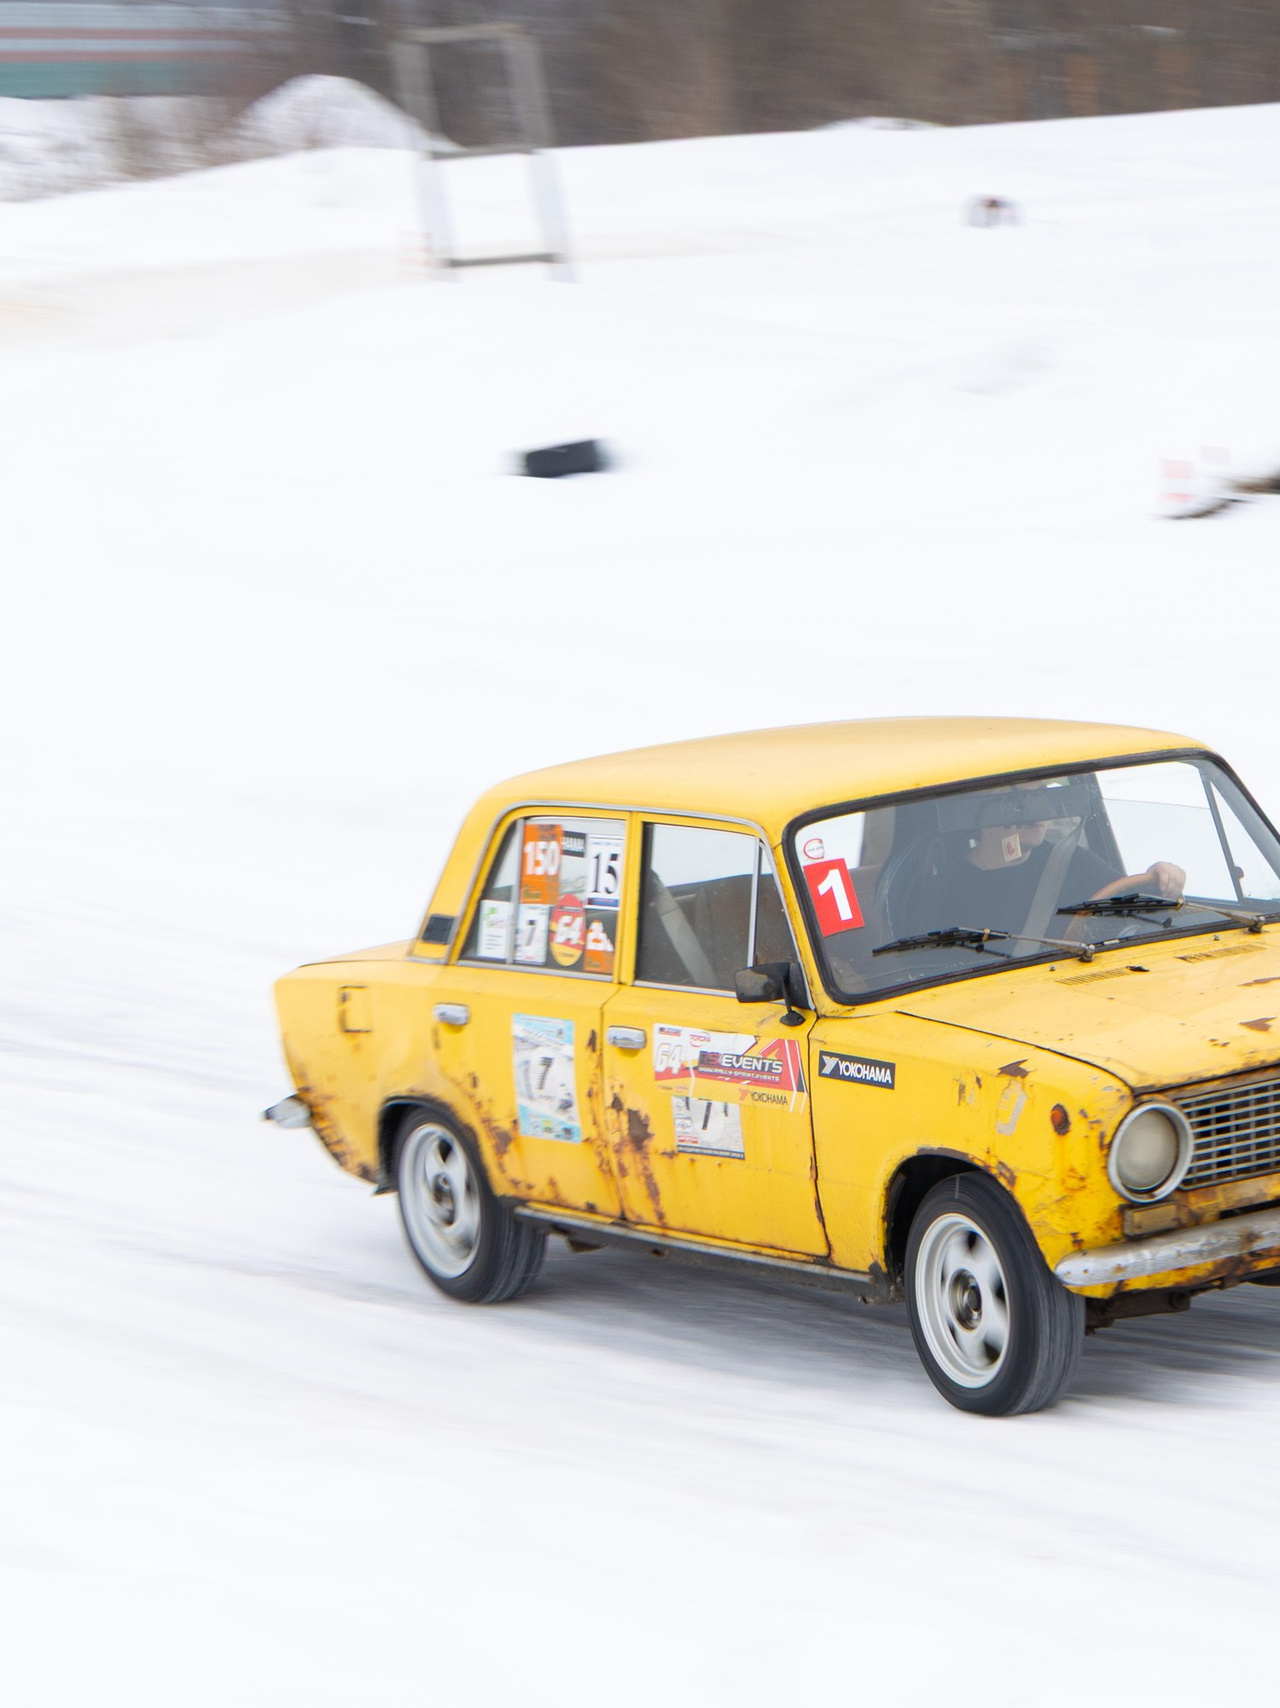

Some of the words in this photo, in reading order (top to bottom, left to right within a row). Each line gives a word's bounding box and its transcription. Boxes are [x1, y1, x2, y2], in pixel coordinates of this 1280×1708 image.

[524, 841, 560, 875] 150
[591, 852, 619, 895] 15
[817, 868, 853, 921] 1
[537, 1056, 554, 1090] 7
[655, 1042, 683, 1075] 64
[838, 1059, 892, 1084] YOKOHAMA
[750, 1090, 789, 1106] YOKOHAMA
